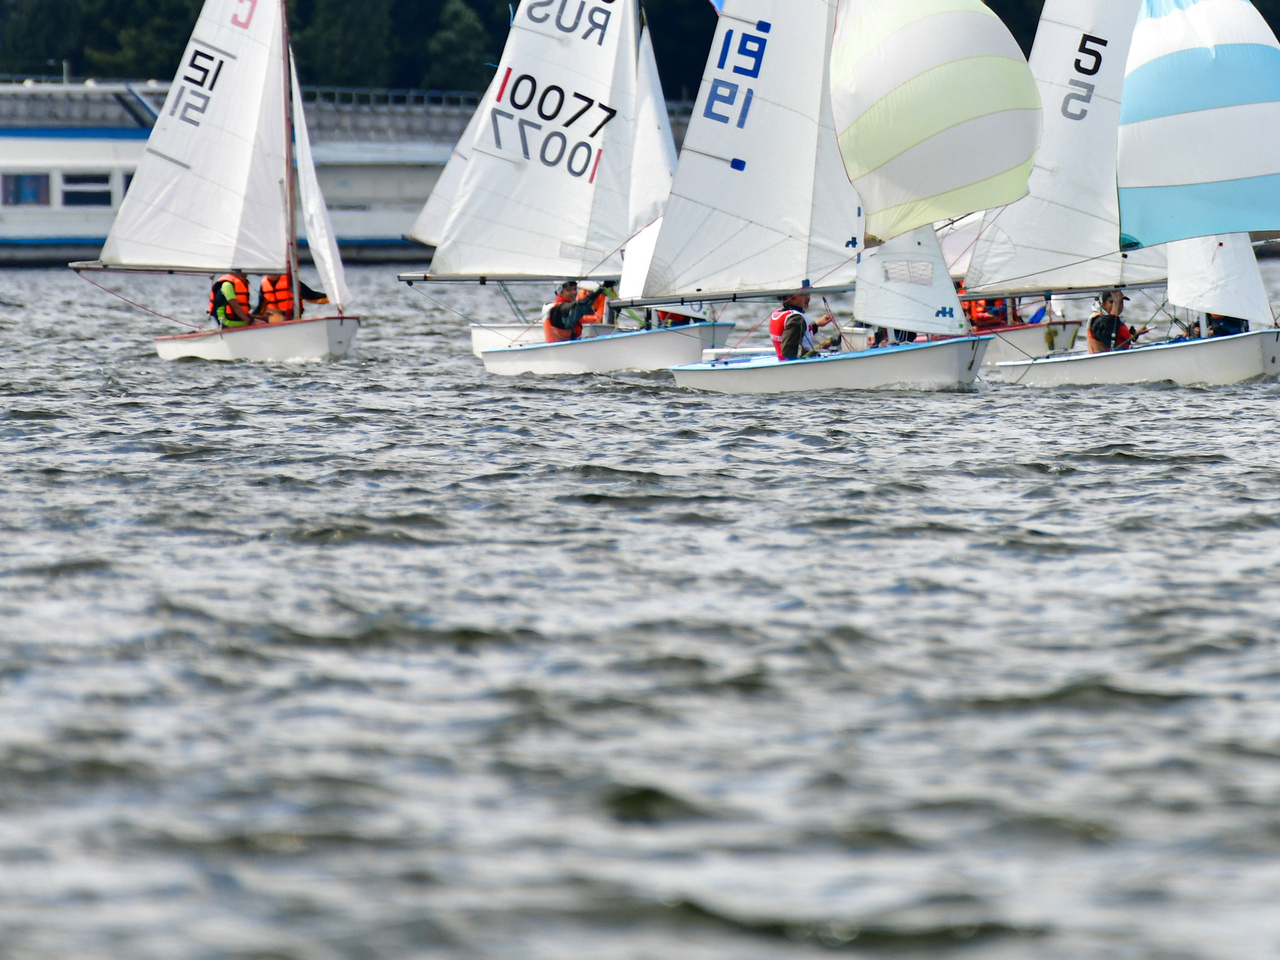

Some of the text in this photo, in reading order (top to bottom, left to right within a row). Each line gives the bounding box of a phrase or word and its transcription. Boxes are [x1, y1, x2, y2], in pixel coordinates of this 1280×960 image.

[183, 49, 224, 91] 51
[717, 29, 767, 78] 19
[1074, 33, 1108, 76] 5
[496, 67, 617, 138] 10077
